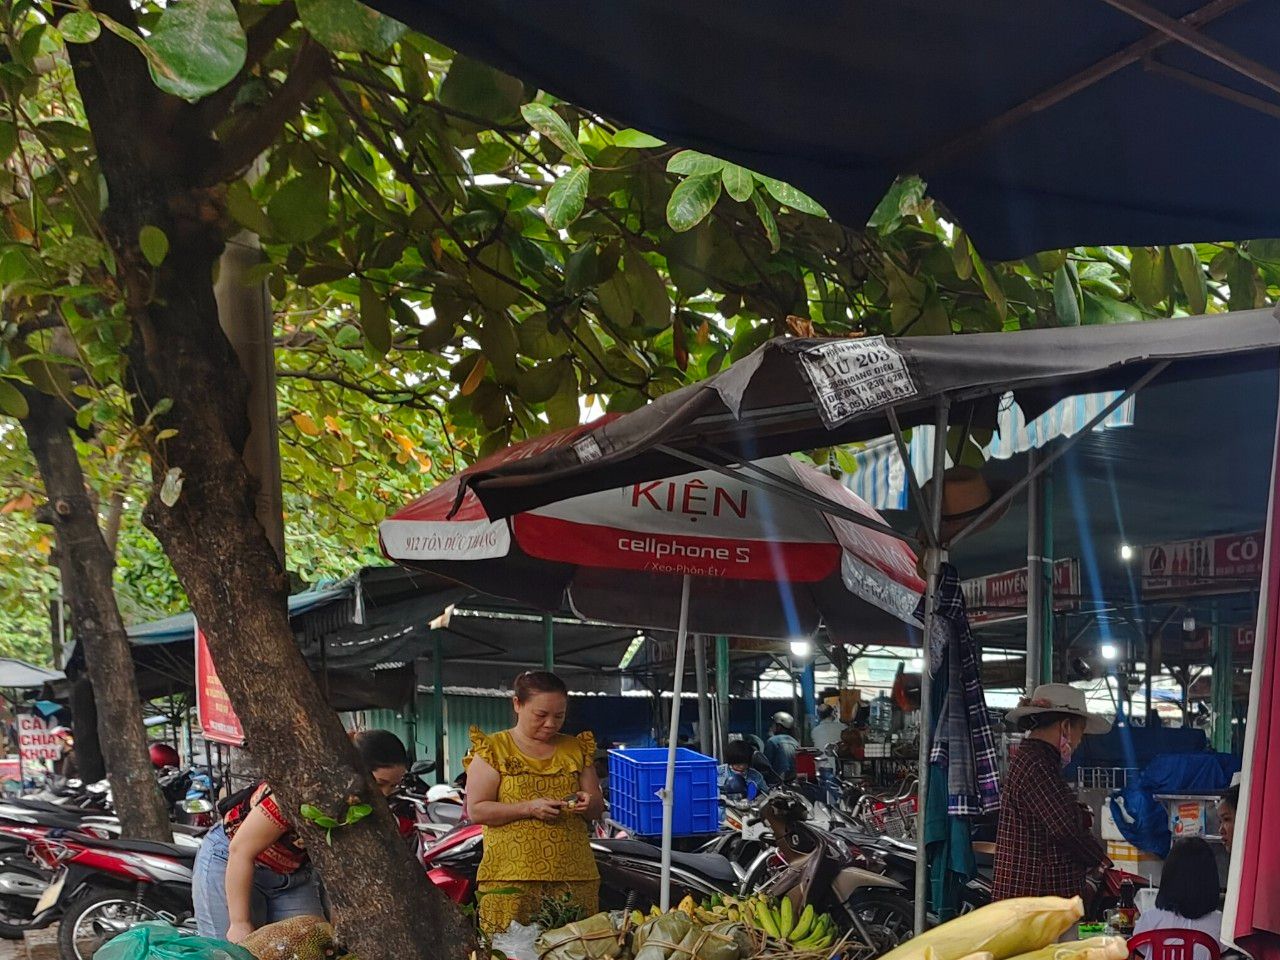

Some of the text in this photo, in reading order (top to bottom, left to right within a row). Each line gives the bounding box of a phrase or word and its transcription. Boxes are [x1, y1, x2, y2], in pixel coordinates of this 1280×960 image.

[855, 349, 891, 369] 203
[631, 479, 748, 522] KIỆN
[618, 537, 750, 563] cellphone S
[1226, 537, 1259, 562] CÔ
